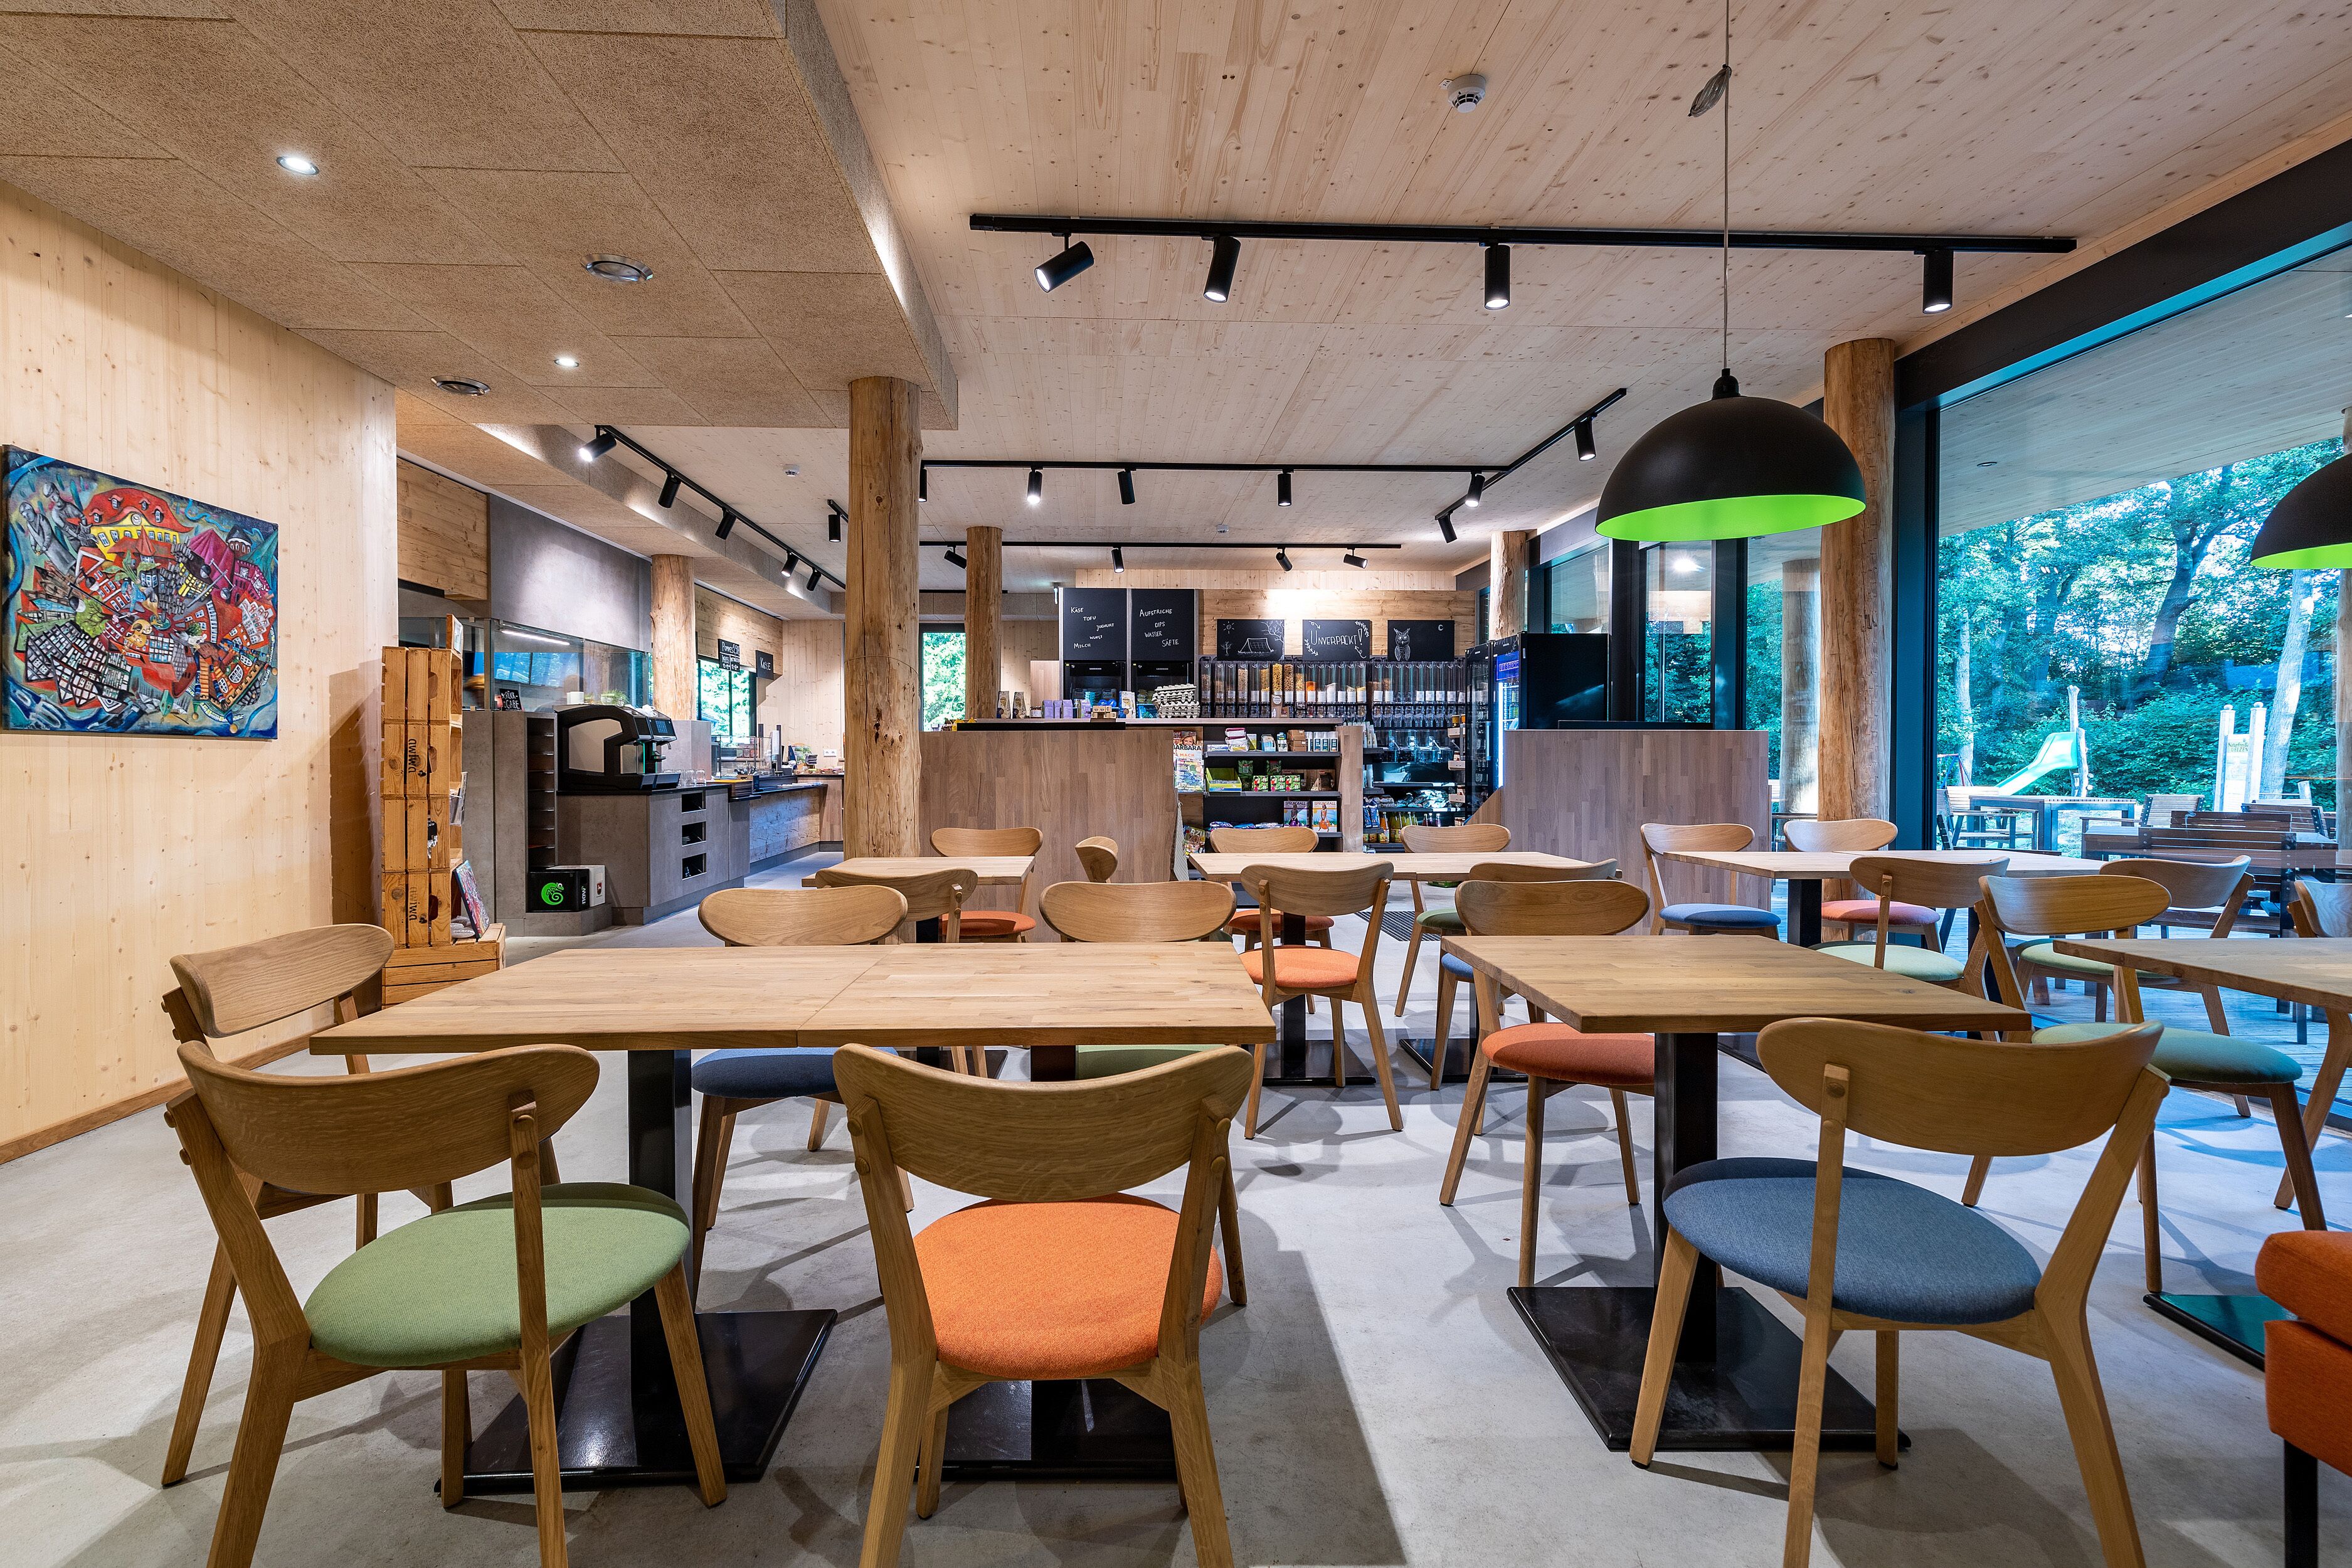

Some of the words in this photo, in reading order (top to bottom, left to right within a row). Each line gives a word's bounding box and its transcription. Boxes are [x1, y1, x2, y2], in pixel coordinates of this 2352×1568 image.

[1139, 608, 1173, 617] AUFSTRICHE
[1096, 623, 1114, 632] JOGHURT
[1310, 628, 1362, 645] UNVERPACKT!
[1162, 638, 1179, 647] SÄFTE
[760, 657, 771, 670] KASSE
[506, 700, 521, 709] GABE
